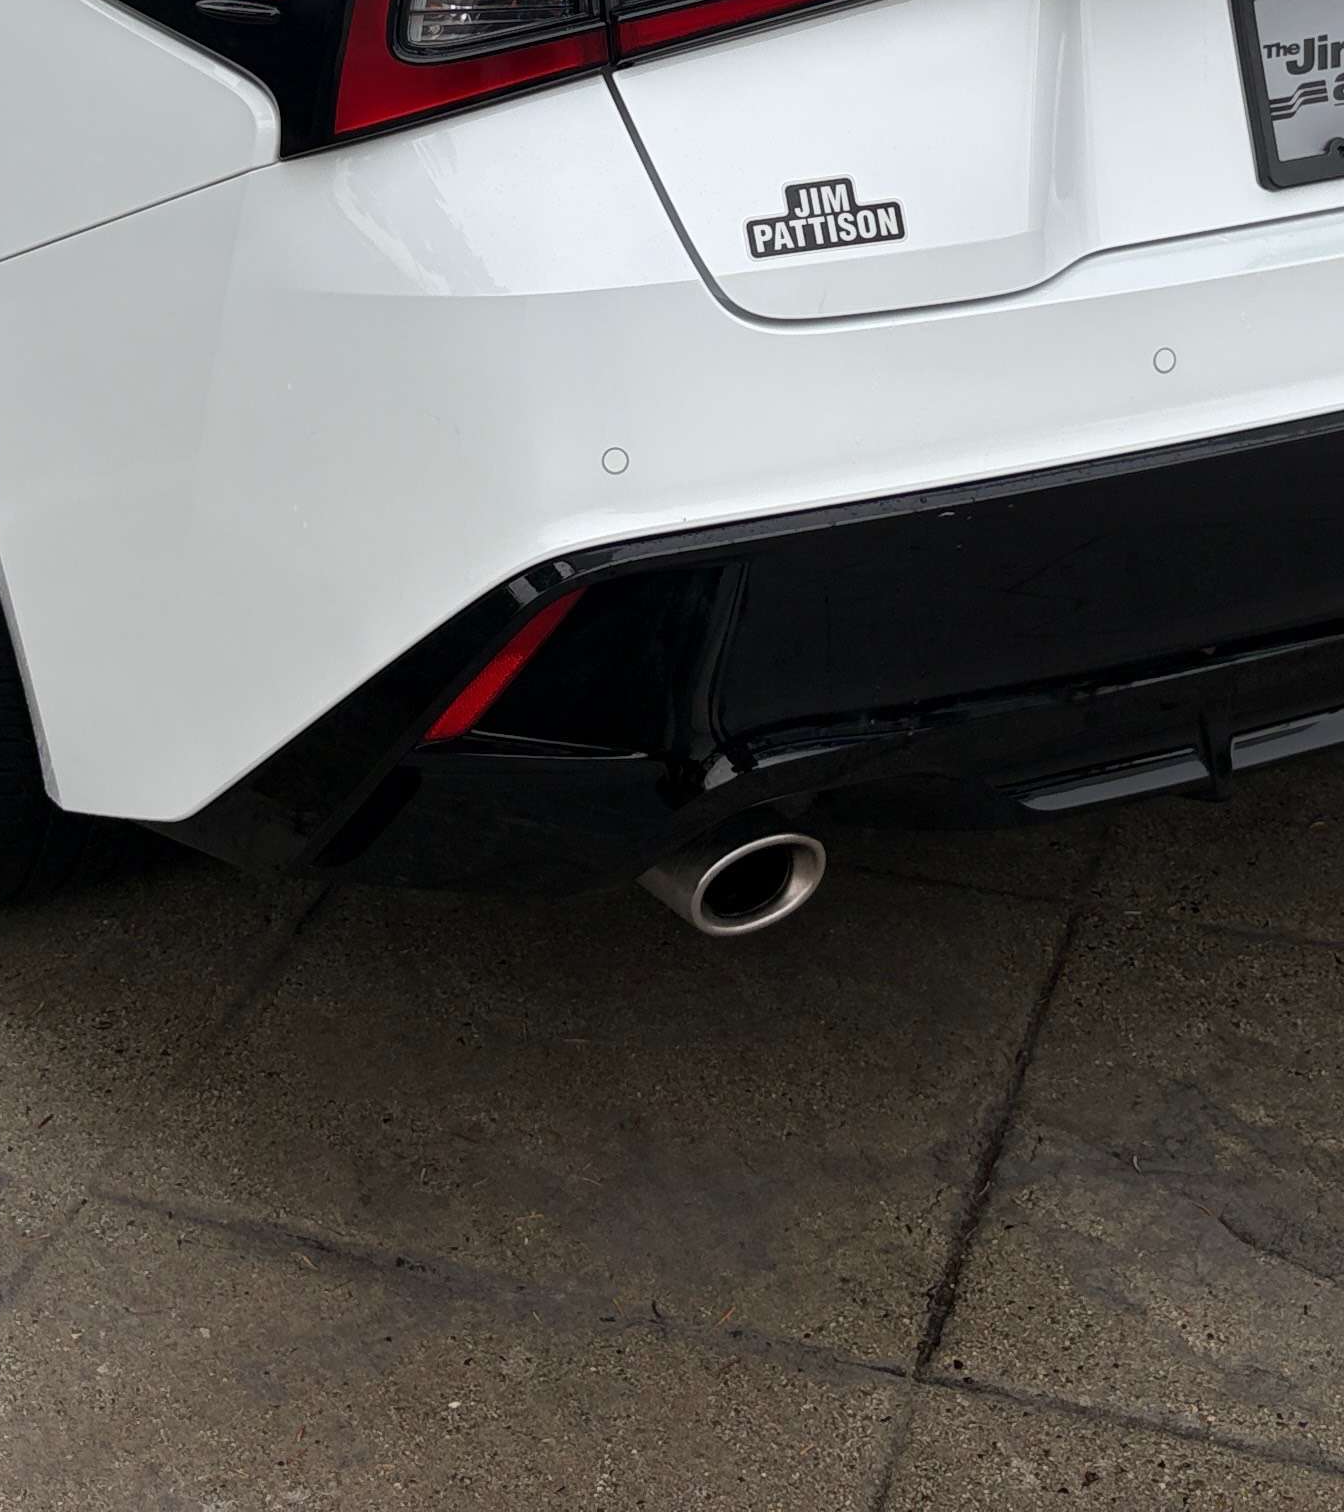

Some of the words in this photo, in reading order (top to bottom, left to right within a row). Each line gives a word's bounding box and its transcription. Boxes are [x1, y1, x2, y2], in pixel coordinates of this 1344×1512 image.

[1263, 39, 1300, 60] The
[794, 183, 851, 218] JIM
[752, 206, 900, 253] PATTISON
